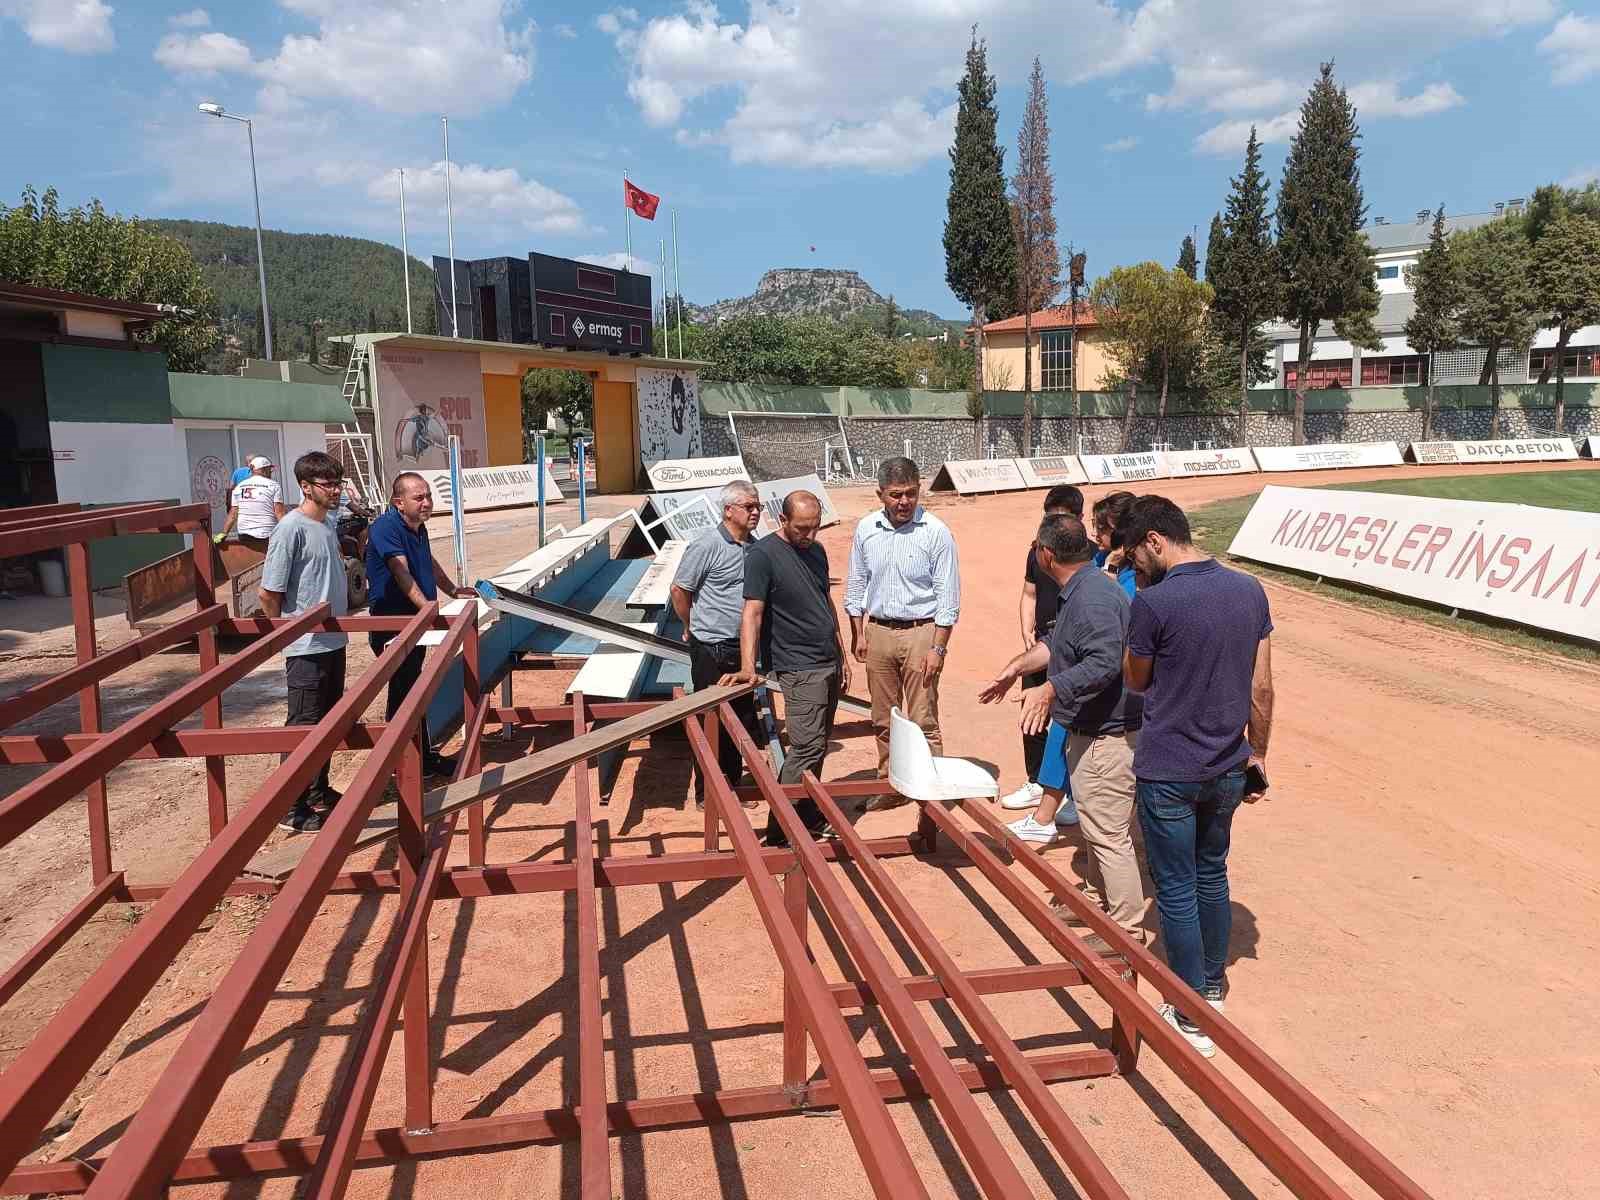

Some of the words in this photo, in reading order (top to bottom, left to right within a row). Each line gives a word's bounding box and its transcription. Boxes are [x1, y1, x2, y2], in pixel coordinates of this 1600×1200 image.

[588, 323, 623, 338] ermaş
[1467, 444, 1515, 457] DATÇA
[1516, 443, 1564, 454] BETON
[1113, 456, 1137, 467] BİZİM
[1136, 455, 1156, 466] YAPI
[660, 469, 686, 481] Ford
[1122, 468, 1157, 480] MARKET
[1271, 508, 1453, 574] KARDEŞLER
